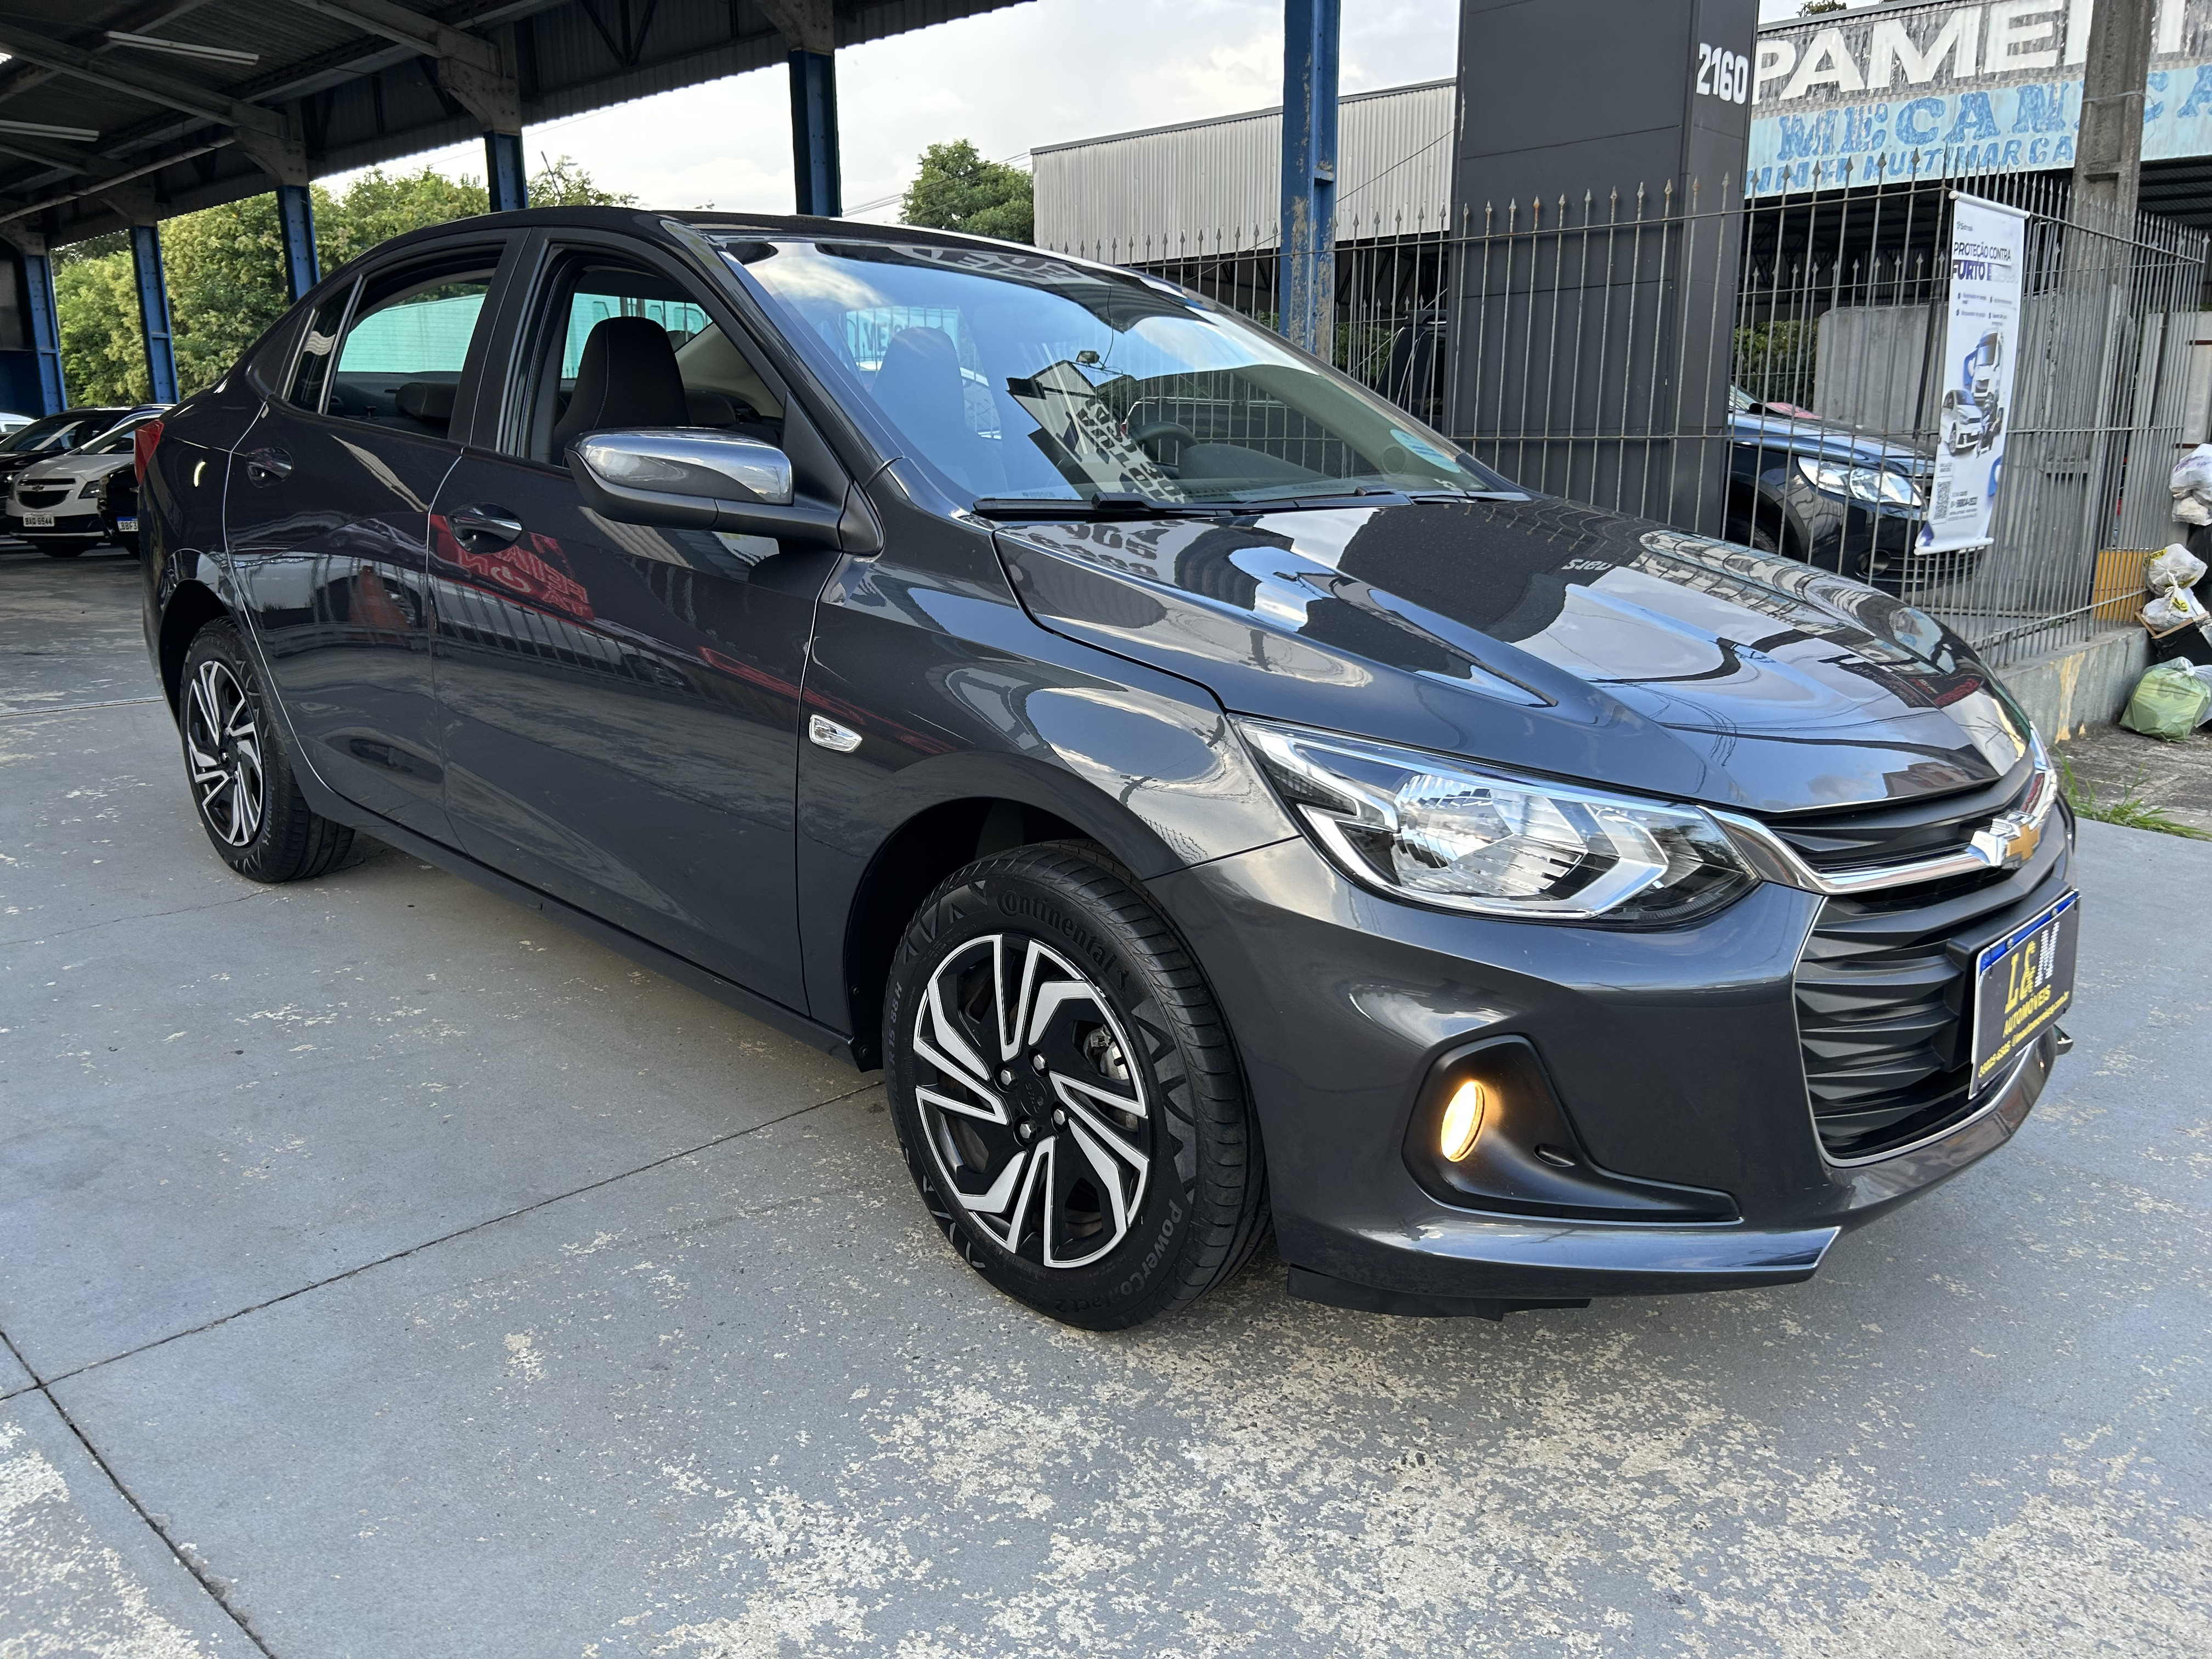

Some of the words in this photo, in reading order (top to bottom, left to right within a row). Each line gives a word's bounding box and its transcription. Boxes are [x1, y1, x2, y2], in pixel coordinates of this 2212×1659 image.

[1696, 43, 1748, 104] 2160
[1953, 259, 1985, 280] FURTO
[1954, 241, 1989, 261] PROTEÇÃO
[1990, 246, 2011, 262] CONTRA
[997, 889, 1116, 975] Continental
